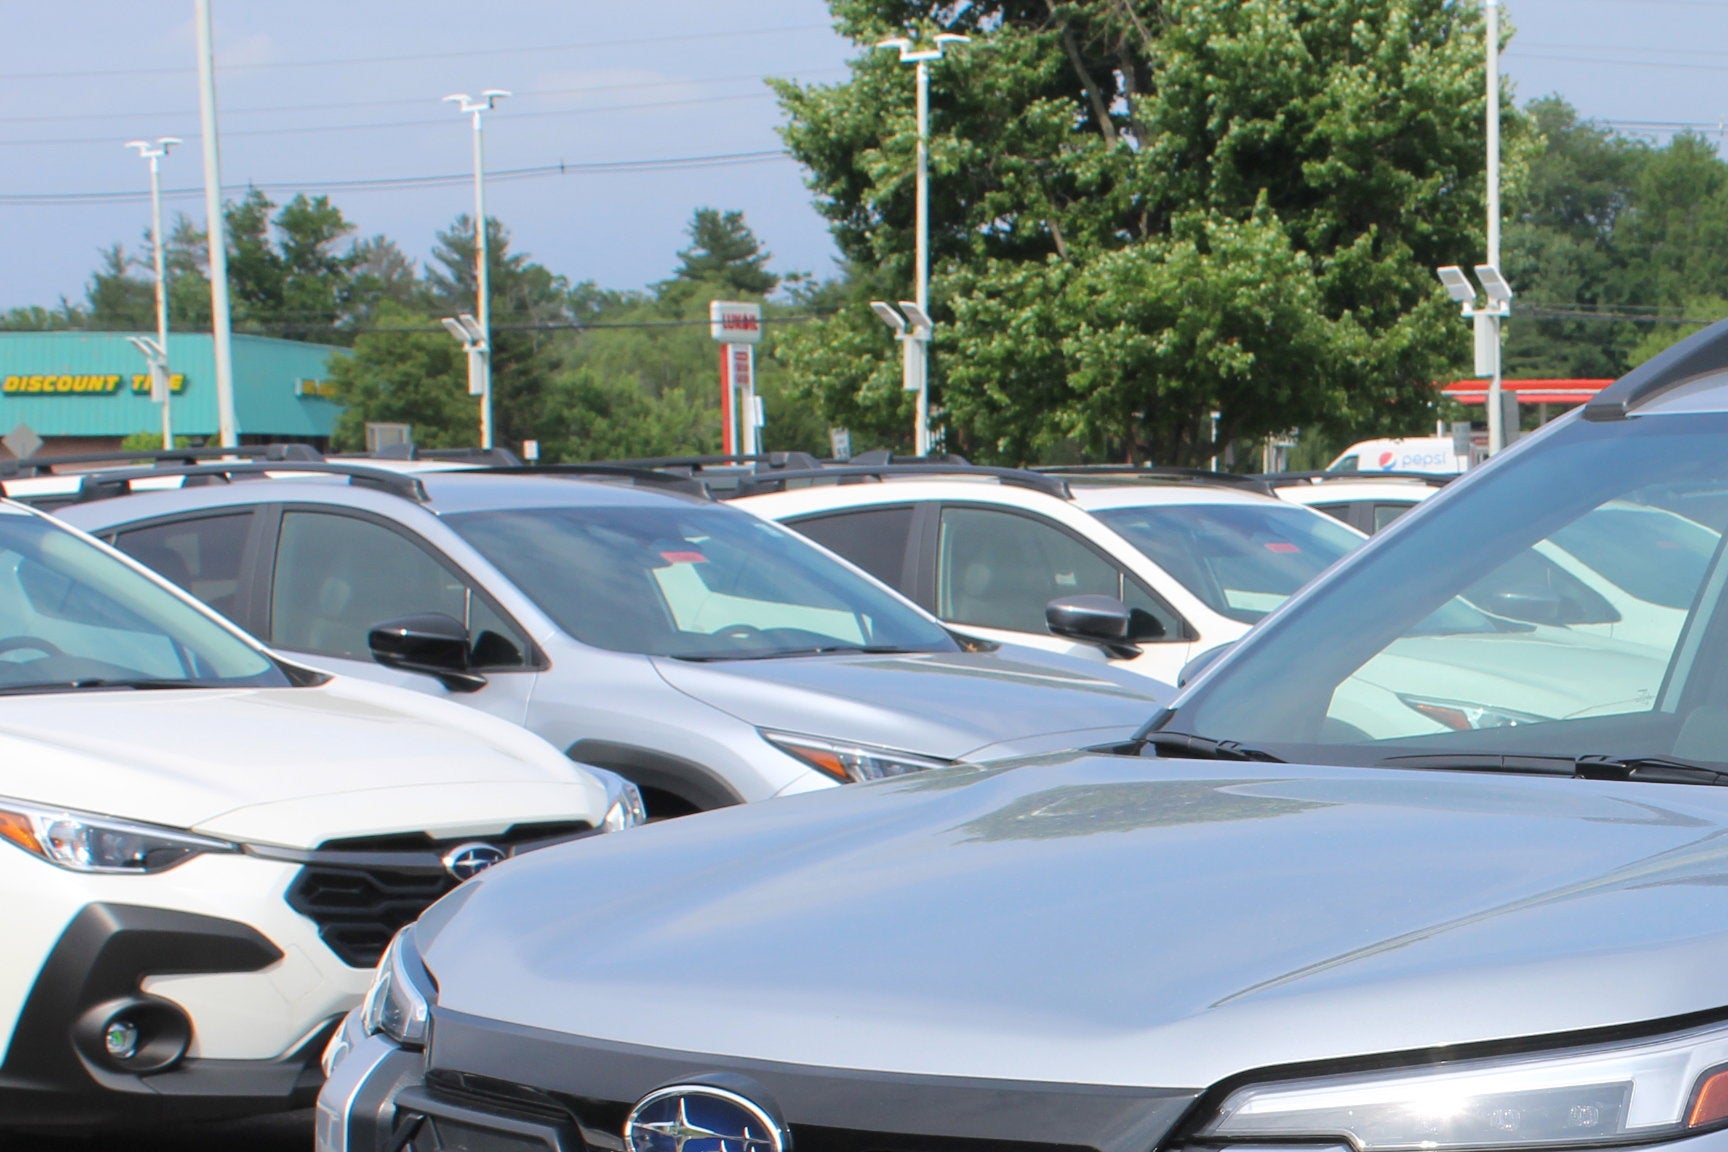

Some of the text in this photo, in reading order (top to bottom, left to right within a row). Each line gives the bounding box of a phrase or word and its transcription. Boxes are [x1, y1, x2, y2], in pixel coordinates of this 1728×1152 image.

[3, 374, 184, 392] DISCOUNT TIE
[1402, 452, 1446, 467] pepsi
